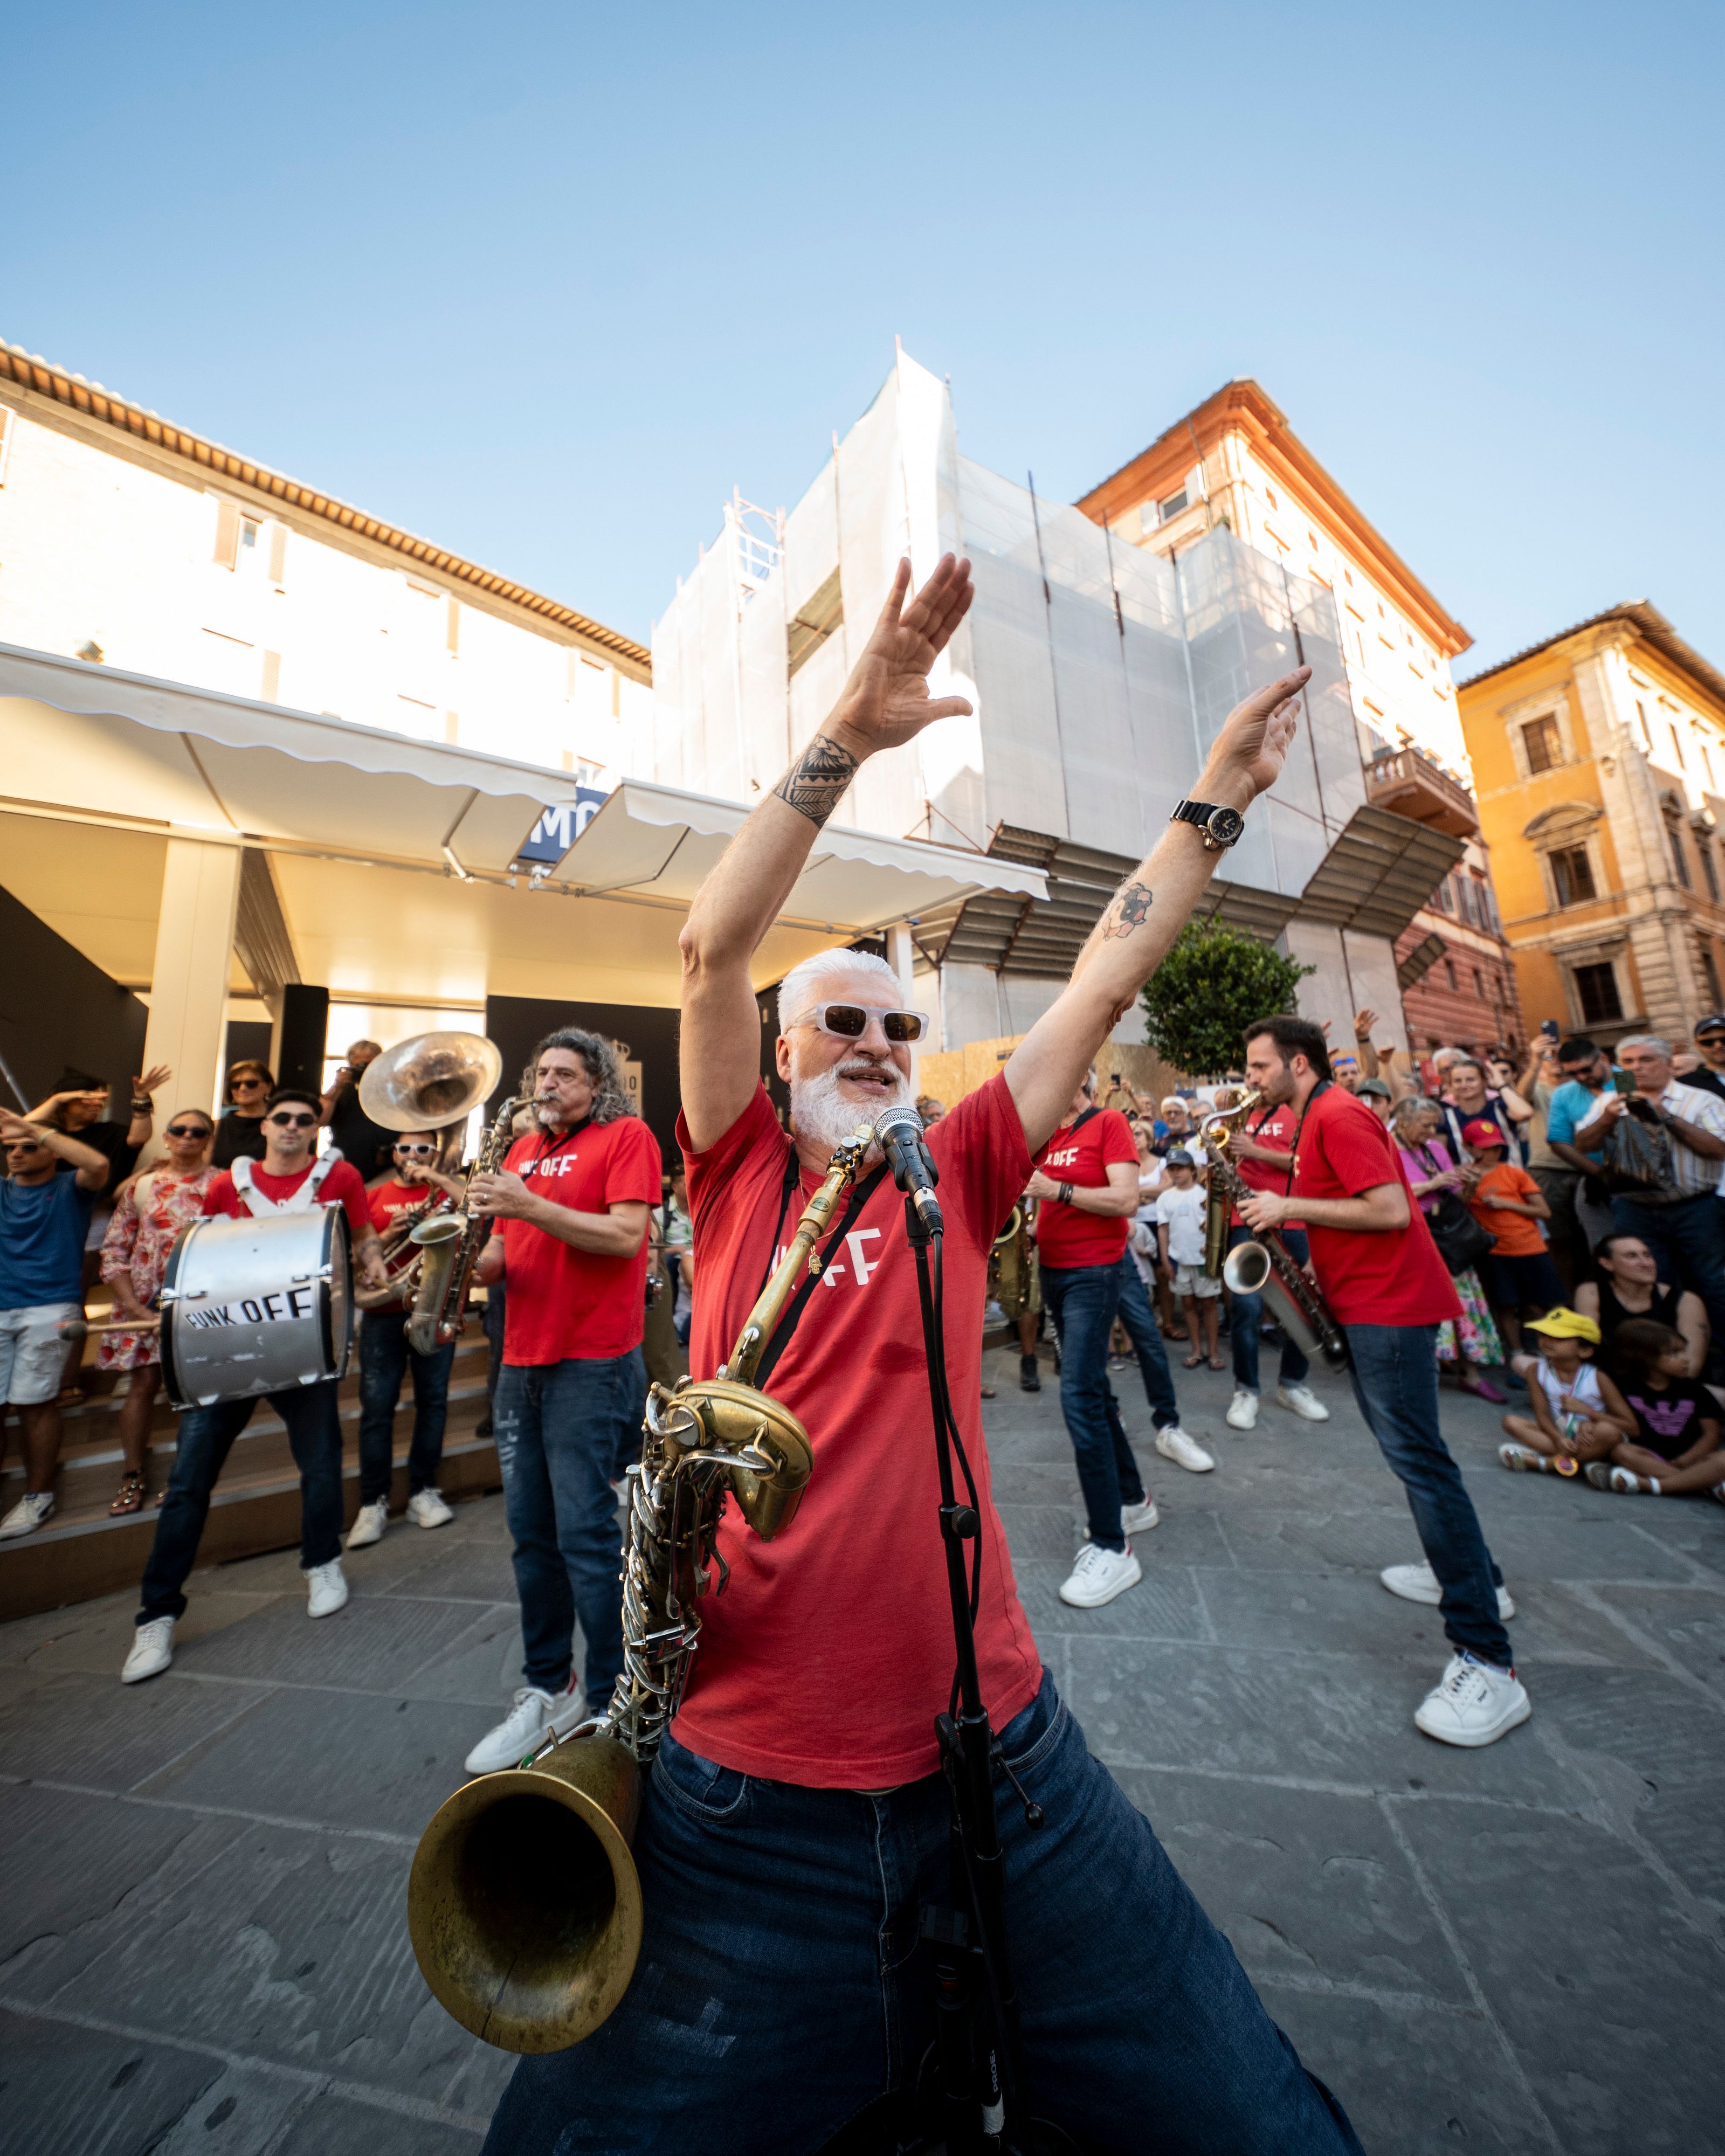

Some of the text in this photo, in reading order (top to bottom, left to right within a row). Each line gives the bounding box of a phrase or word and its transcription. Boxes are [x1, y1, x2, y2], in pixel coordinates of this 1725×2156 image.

[540, 1154, 577, 1177] OFF
[1053, 1147, 1079, 1166] OFF
[185, 1286, 311, 1329] FUNK OFF
